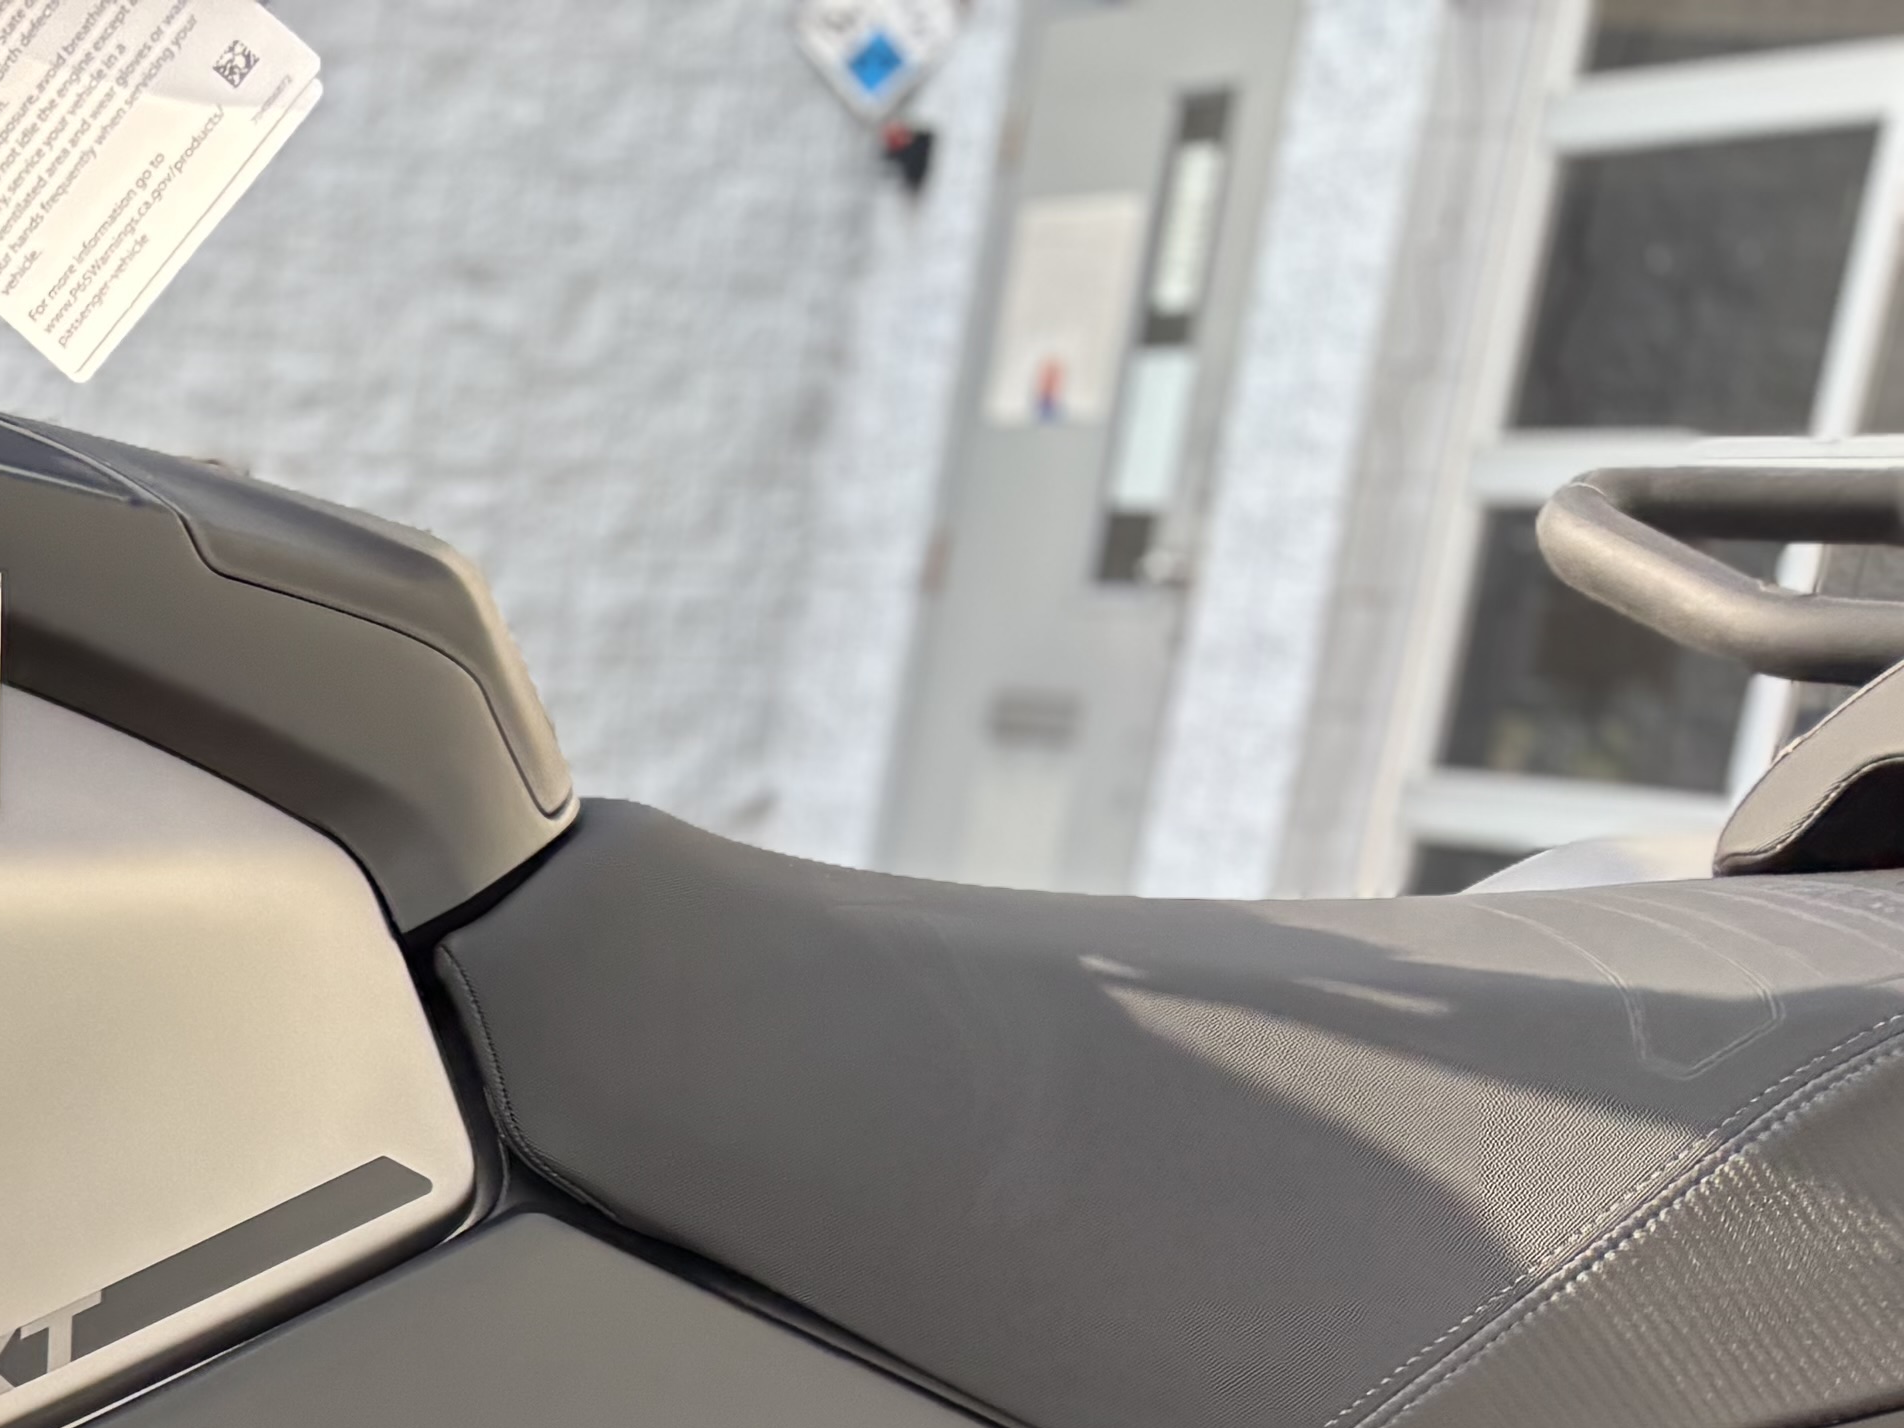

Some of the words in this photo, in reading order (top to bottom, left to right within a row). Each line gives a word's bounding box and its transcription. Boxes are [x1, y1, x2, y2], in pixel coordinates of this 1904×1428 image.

[4, 145, 46, 195] service
[41, 114, 73, 151] your
[63, 65, 107, 118] vehicle
[98, 50, 119, 70] in
[113, 41, 127, 56] a
[7, 209, 45, 254] hands
[38, 142, 100, 216] frequently
[91, 104, 127, 147] when
[121, 44, 177, 111] servicing
[169, 13, 201, 50] your
[13, 119, 41, 150] idle
[34, 95, 59, 123] the
[52, 48, 97, 101] engine
[89, 3, 133, 55] except
[30, 51, 67, 94] avoid
[43, 146, 71, 179] area
[64, 117, 92, 149] and
[87, 84, 119, 122] wear
[111, 38, 155, 90] gloves
[148, 24, 166, 44] or
[26, 295, 51, 322] For
[45, 262, 79, 301] more
[70, 186, 137, 265] information
[132, 167, 156, 192] go
[148, 150, 166, 170] to
[56, 230, 152, 349] passenger-vehicle
